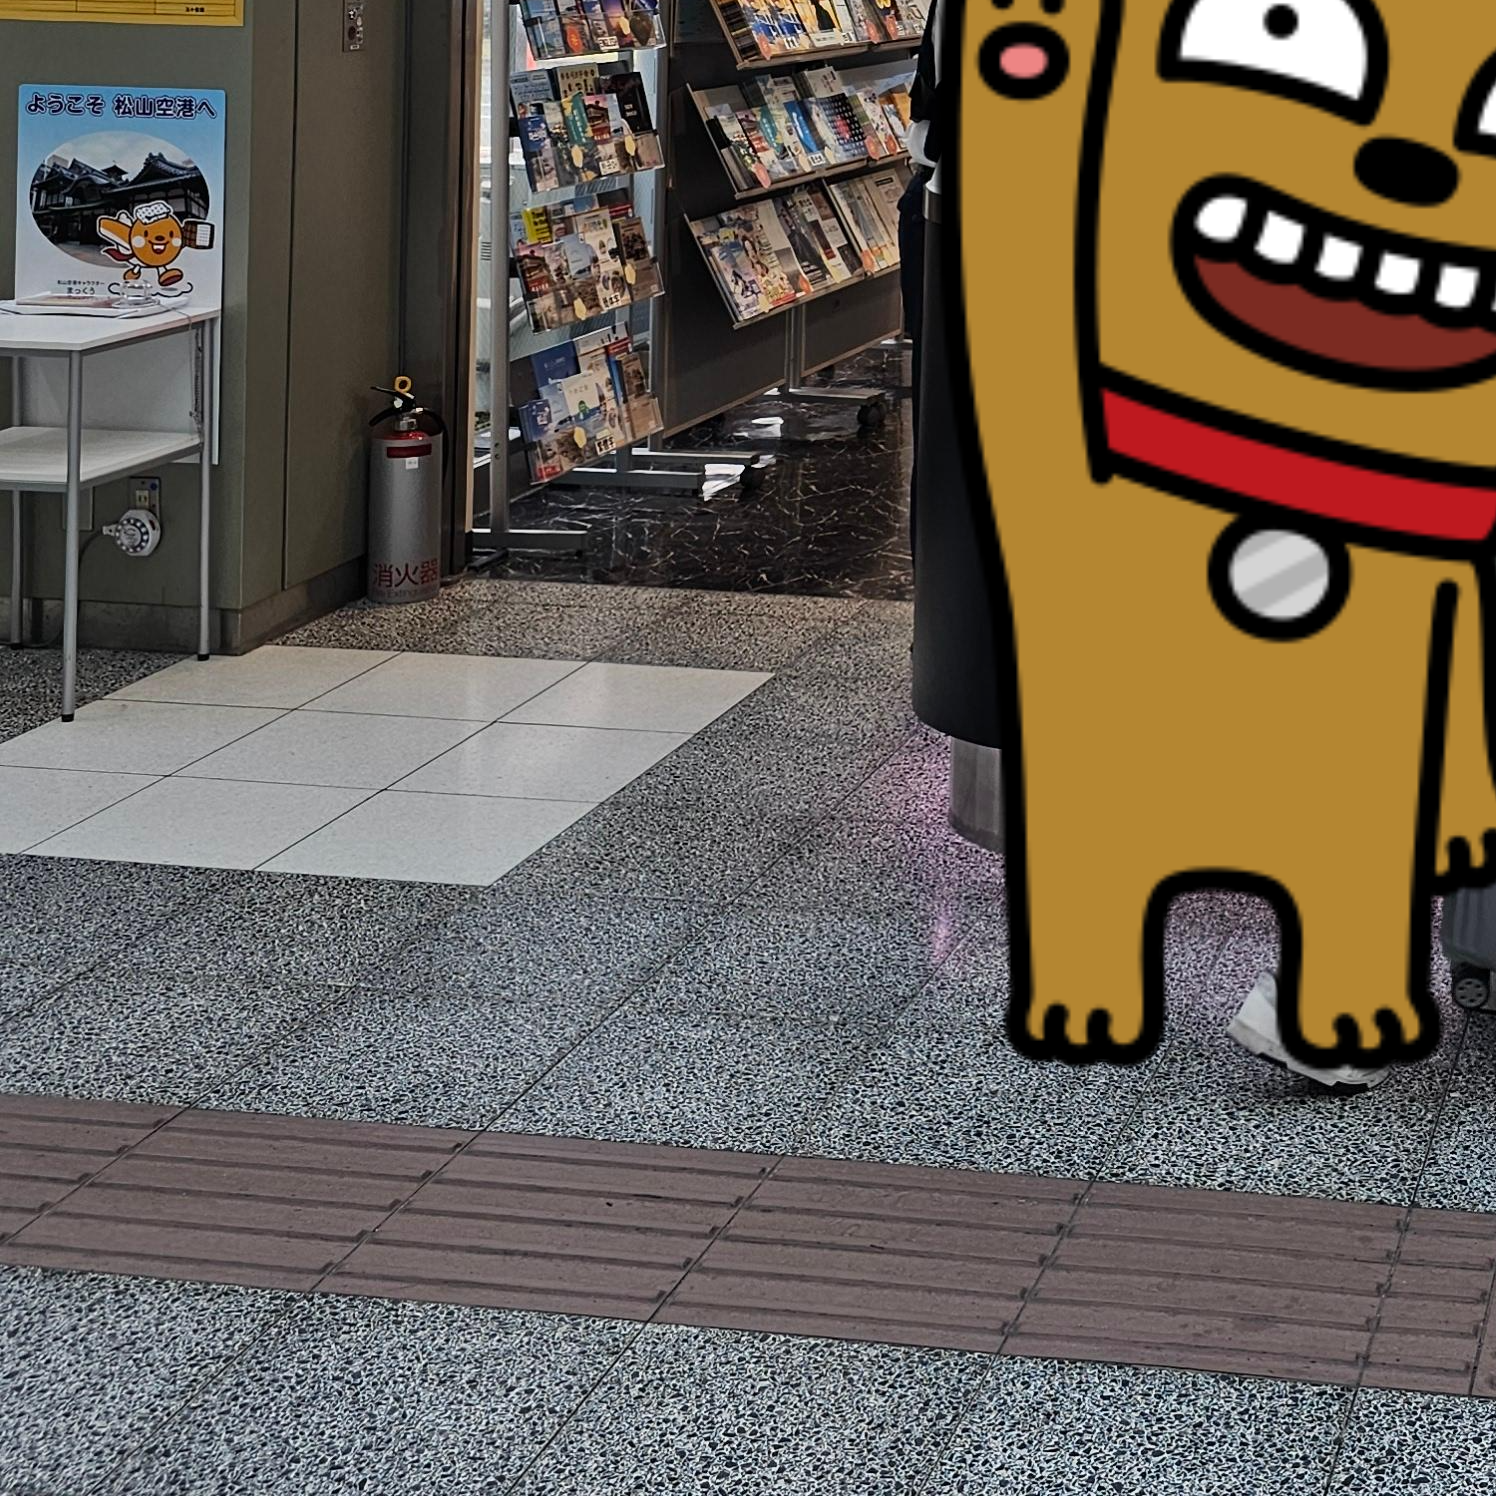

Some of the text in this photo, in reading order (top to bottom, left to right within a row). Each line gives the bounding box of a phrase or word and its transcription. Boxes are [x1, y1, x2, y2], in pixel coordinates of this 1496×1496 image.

[26, 93, 217, 119] ようこそ 松山空港へ
[373, 558, 439, 589] 消火器
